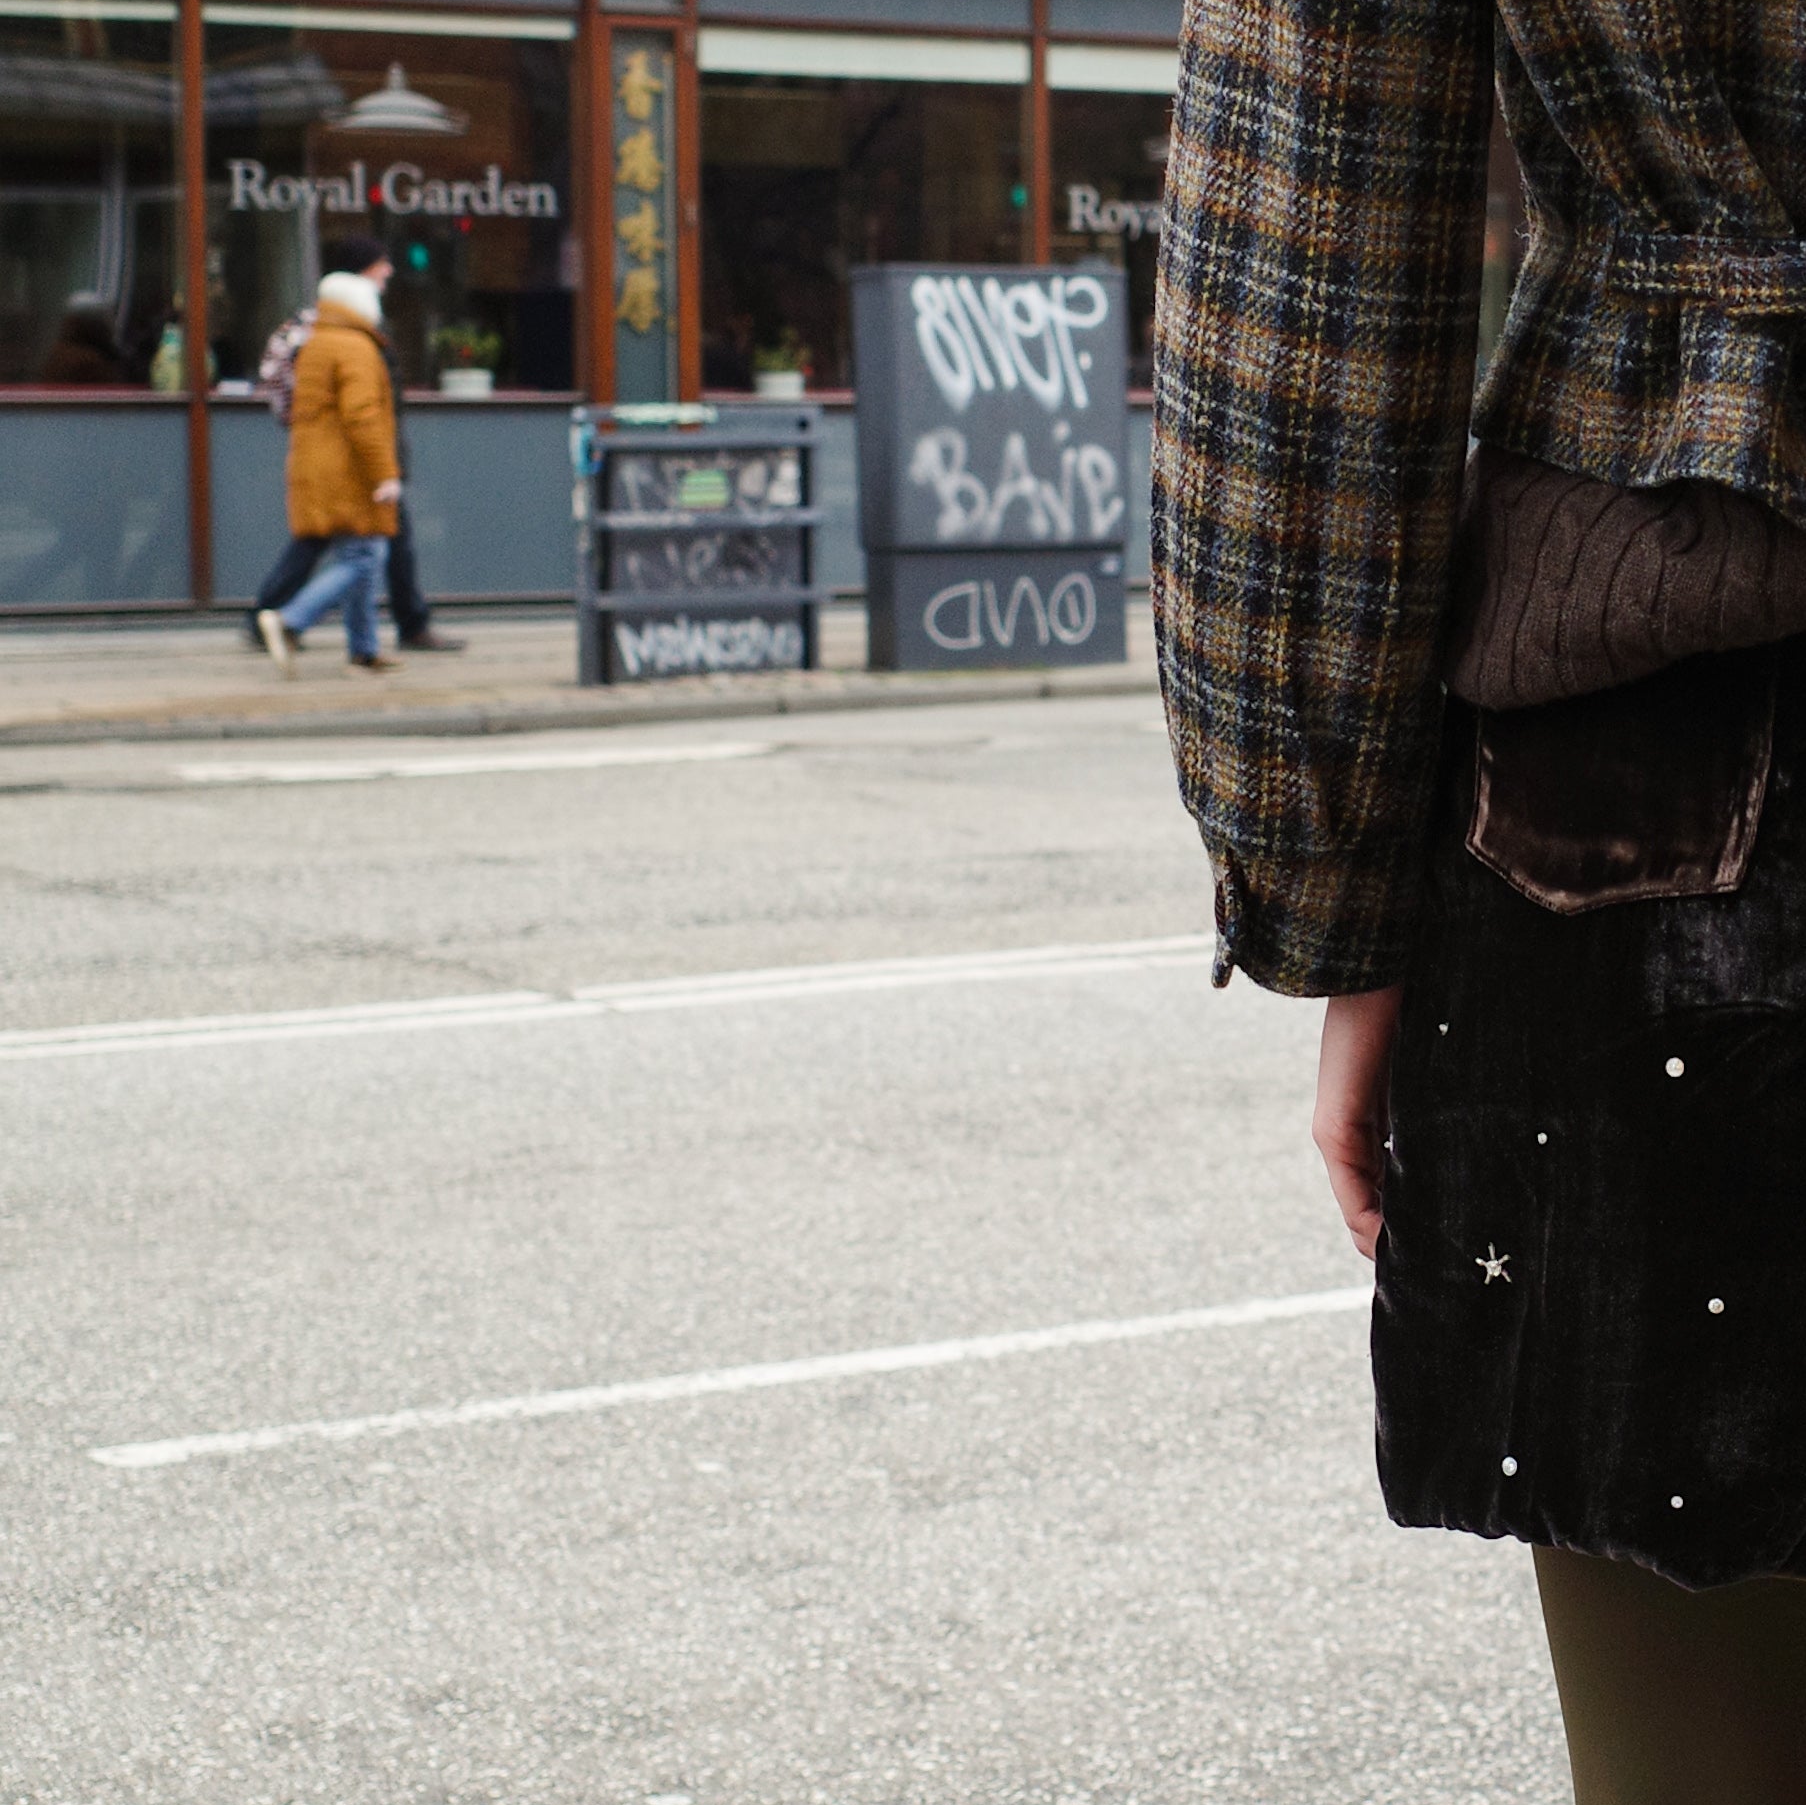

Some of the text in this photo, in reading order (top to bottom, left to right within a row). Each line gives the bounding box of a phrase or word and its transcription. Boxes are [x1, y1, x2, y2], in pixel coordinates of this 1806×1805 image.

[227, 157, 559, 223] Royal Garden
[1067, 182, 1163, 241] Roya
